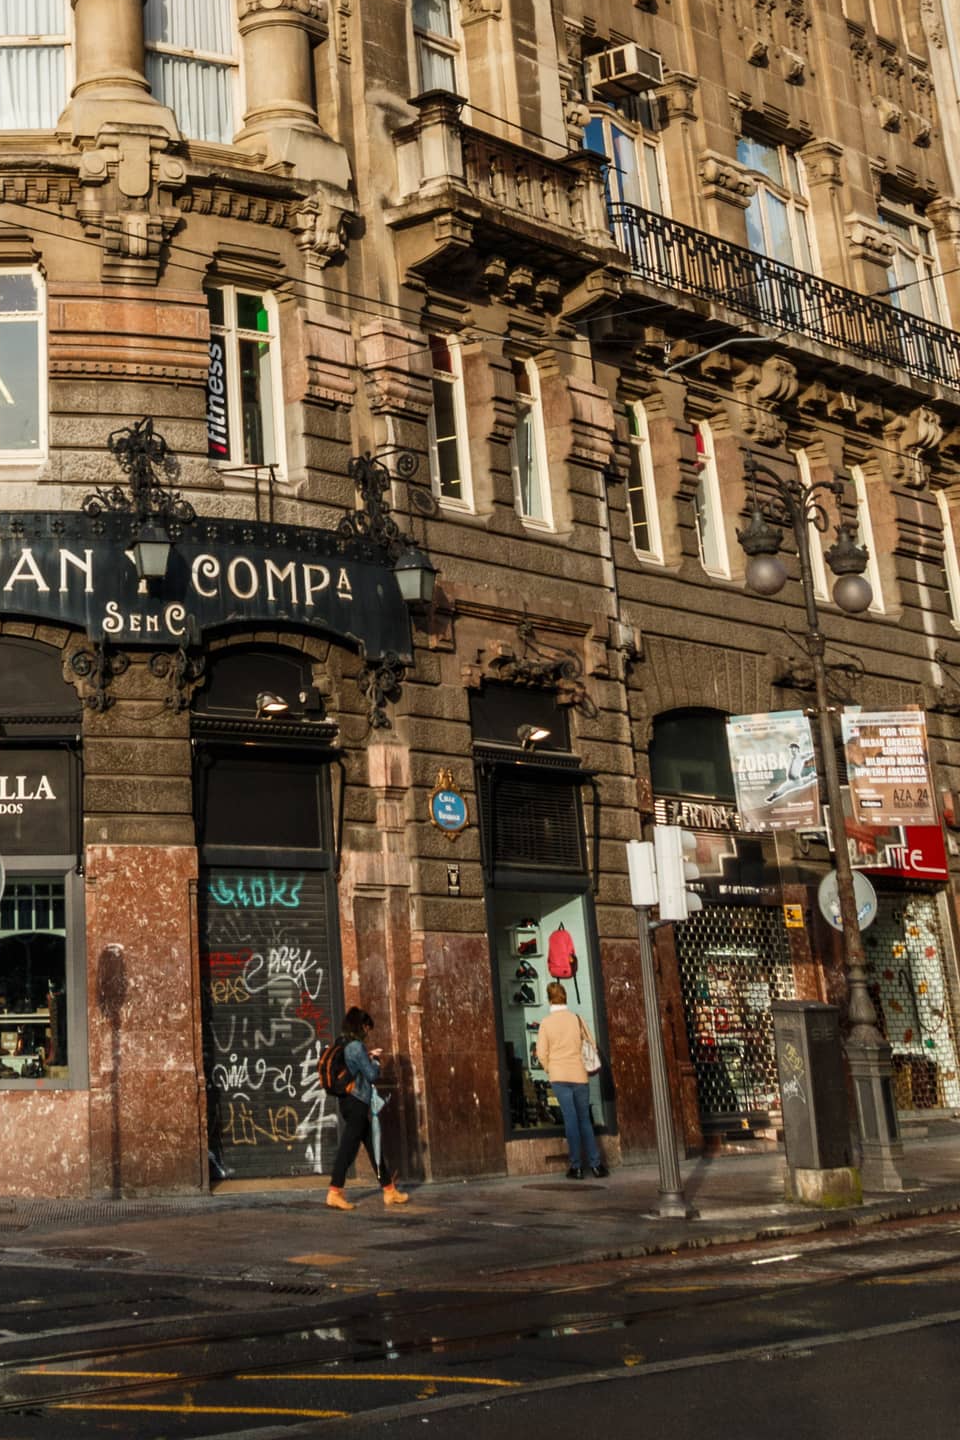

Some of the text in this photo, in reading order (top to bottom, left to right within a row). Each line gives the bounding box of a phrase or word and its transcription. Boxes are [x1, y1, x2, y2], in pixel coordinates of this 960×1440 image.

[879, 728, 897, 736] IGOR
[735, 752, 788, 772] ZORBA
[917, 788, 929, 801] 24
